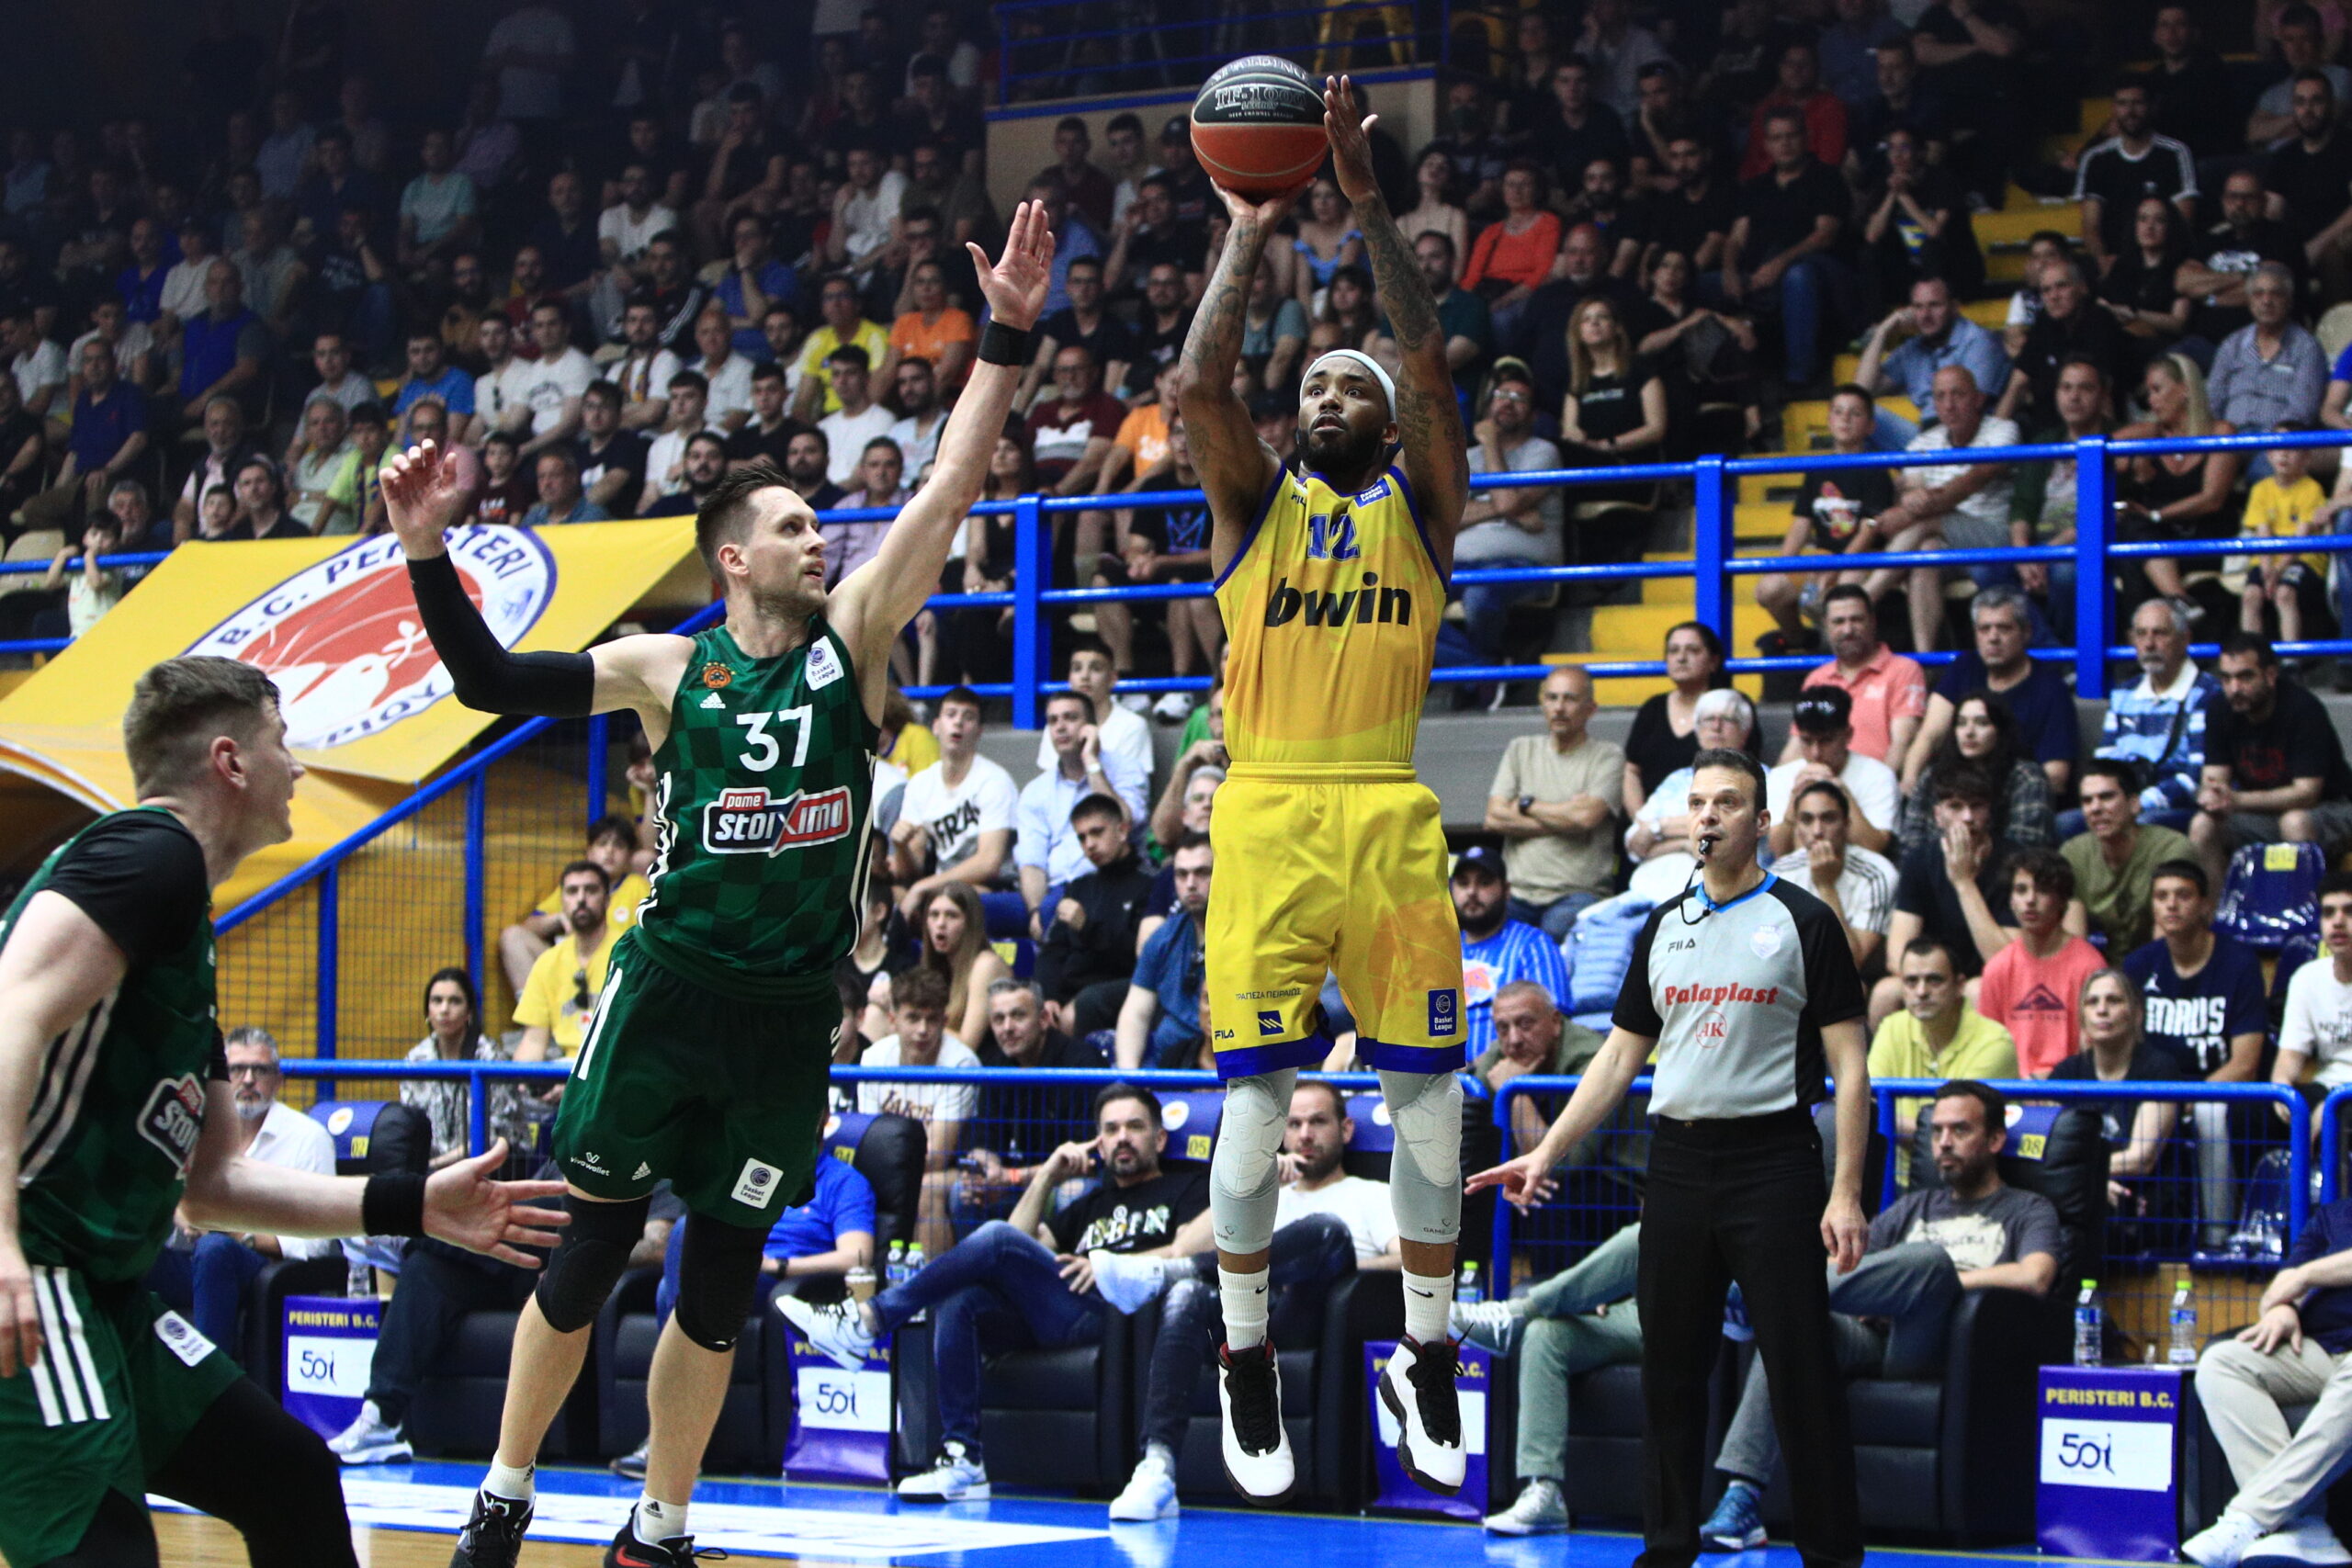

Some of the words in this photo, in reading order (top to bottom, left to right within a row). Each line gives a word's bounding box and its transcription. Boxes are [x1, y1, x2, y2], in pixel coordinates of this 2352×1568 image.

[1306, 513, 1361, 562] 12
[1264, 570, 1411, 627] bwin
[736, 704, 813, 772] 37
[726, 795, 762, 809] pame
[1665, 981, 1780, 1007] Palaplast
[1434, 1016, 1453, 1024] Basket
[1434, 1023, 1453, 1032] League
[1214, 1028, 1235, 1041] FILA
[741, 1191, 762, 1202] League
[742, 1184, 764, 1197] Basket
[288, 1311, 349, 1328] PERISTERI
[2045, 1388, 2135, 1407] PERISTERI
[2139, 1392, 2175, 1409] B.C.
